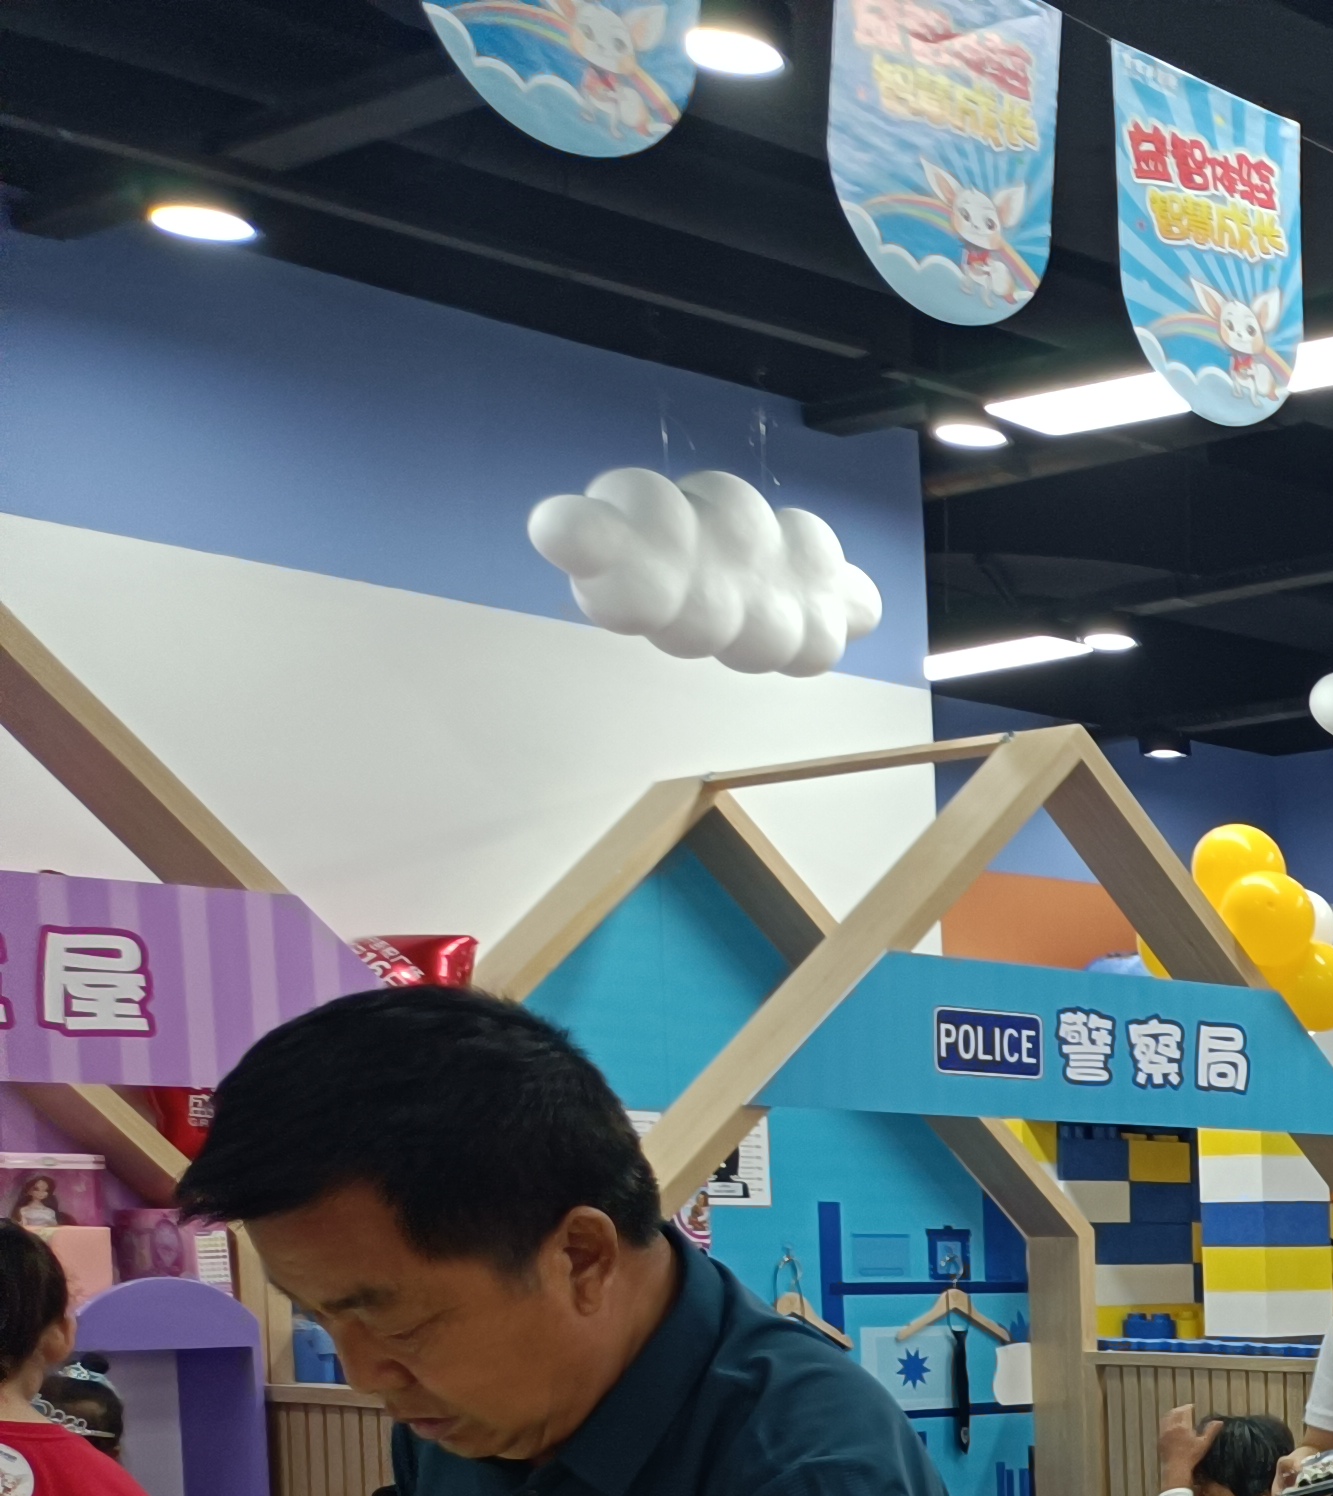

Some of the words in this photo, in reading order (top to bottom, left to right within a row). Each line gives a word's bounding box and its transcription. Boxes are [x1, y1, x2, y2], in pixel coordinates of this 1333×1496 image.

[1127, 122, 1275, 208] 益智体验
[1151, 192, 1286, 258] 智慧成长
[0, 928, 152, 1034] 屋
[939, 1023, 1037, 1065] POLICE
[1058, 1009, 1250, 1092] 警察局
